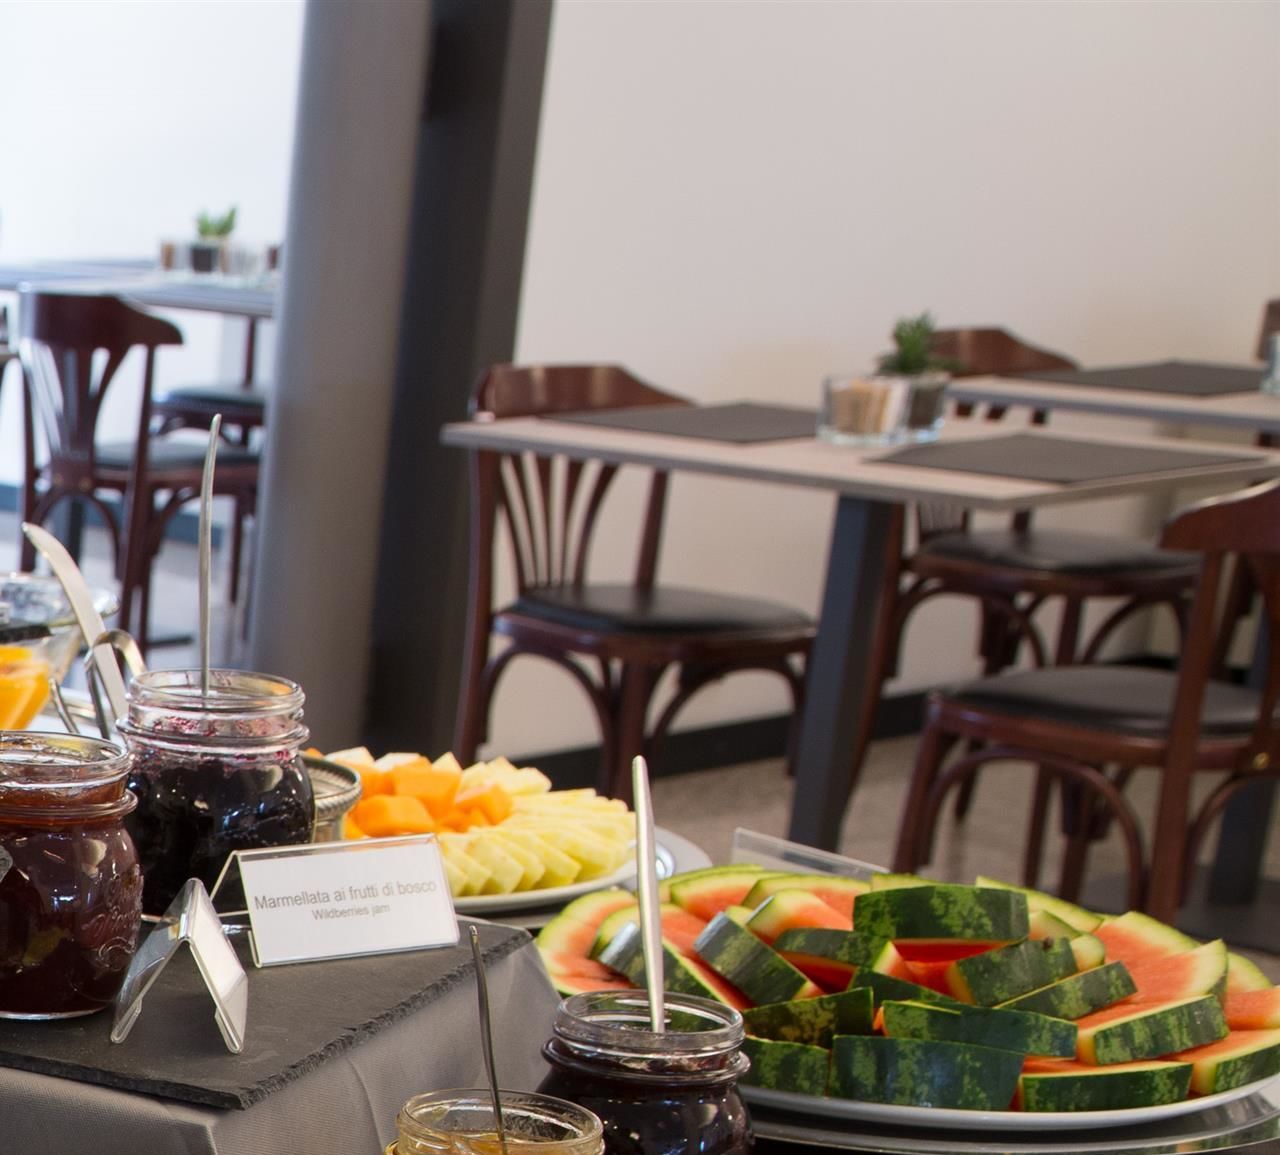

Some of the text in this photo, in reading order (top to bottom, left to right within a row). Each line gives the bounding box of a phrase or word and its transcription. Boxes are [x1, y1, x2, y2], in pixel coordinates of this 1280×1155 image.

[254, 880, 436, 911] Marmellata ai frutti di bosco
[312, 904, 390, 920] Wildberries jam
